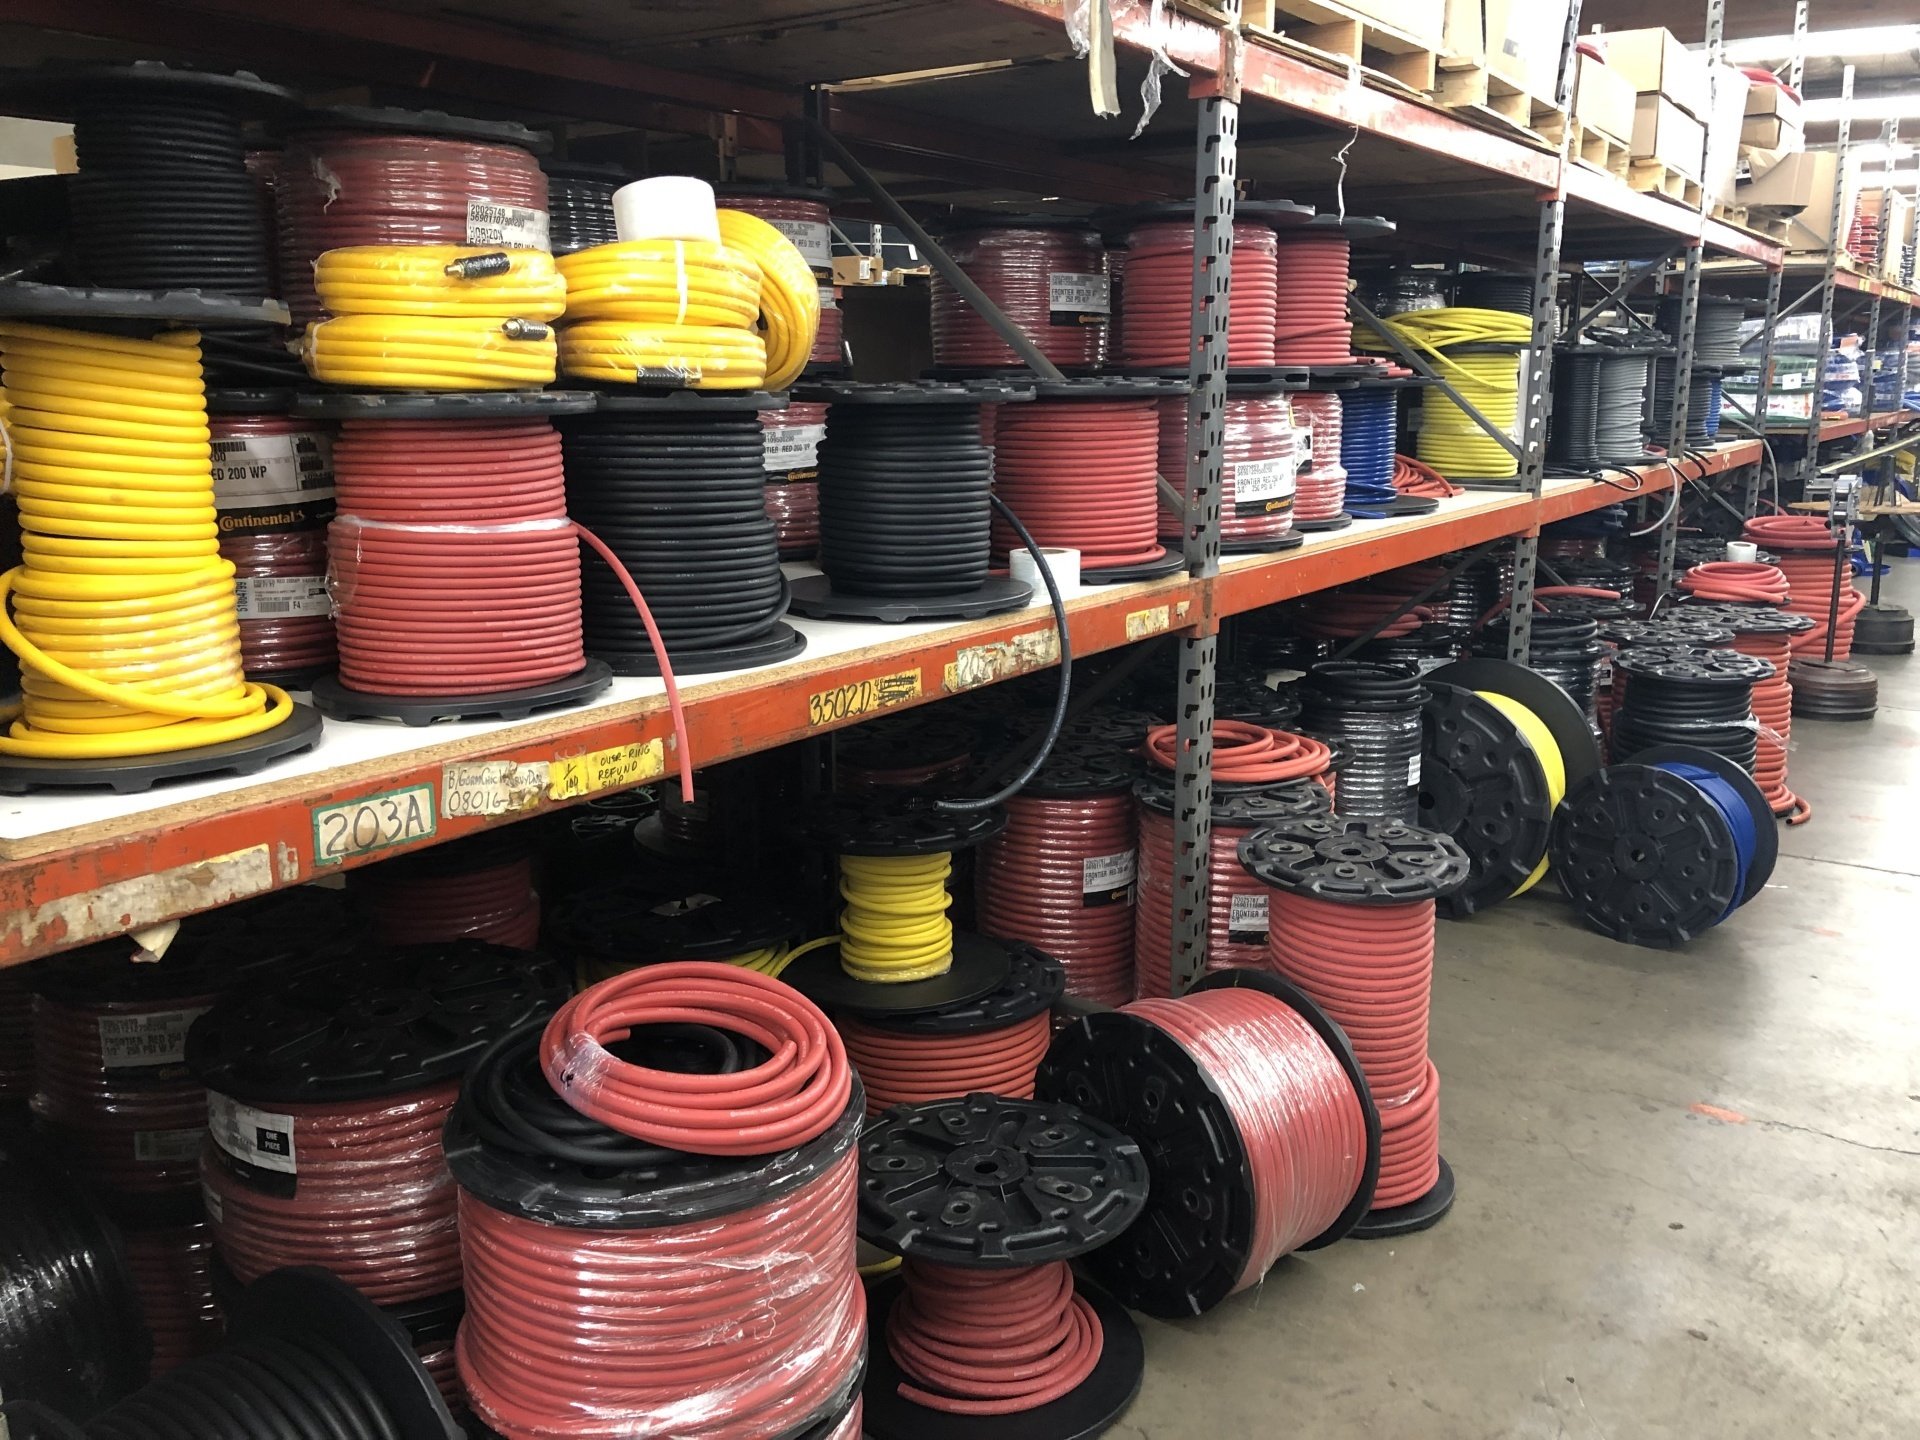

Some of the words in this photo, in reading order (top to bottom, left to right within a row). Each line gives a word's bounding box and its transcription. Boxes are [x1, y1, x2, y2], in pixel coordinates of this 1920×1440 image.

[765, 446, 779, 454] TIER
[208, 468, 225, 481] ED
[227, 466, 247, 480] 200
[248, 465, 267, 479] WP
[1237, 477, 1261, 486] FRONTIER
[219, 511, 296, 532] Continental
[600, 745, 651, 767] OVER-RING
[598, 761, 638, 780] REFUND
[323, 794, 425, 857] 203A
[1232, 909, 1259, 918] FRONTIER
[265, 1131, 278, 1141] ONE
[264, 1140, 281, 1151] PIECE
